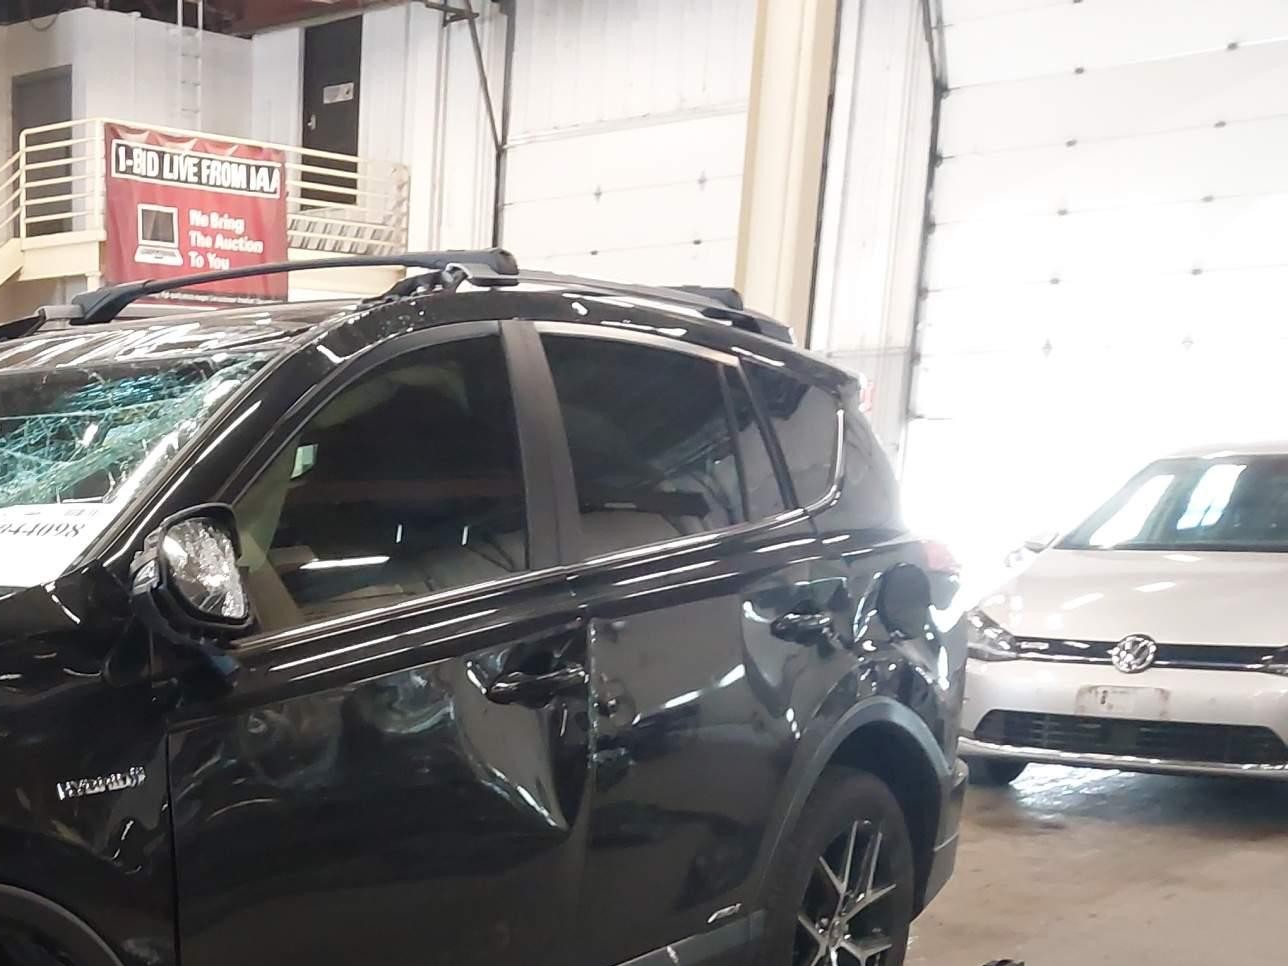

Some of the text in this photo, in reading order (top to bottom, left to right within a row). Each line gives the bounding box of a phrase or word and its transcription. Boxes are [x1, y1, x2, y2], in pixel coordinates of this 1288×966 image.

[162, 153, 200, 182] LIVE
[201, 159, 247, 189] FROM
[211, 211, 245, 235] Bring
[189, 230, 264, 254] The Auction
[188, 250, 230, 270] To You
